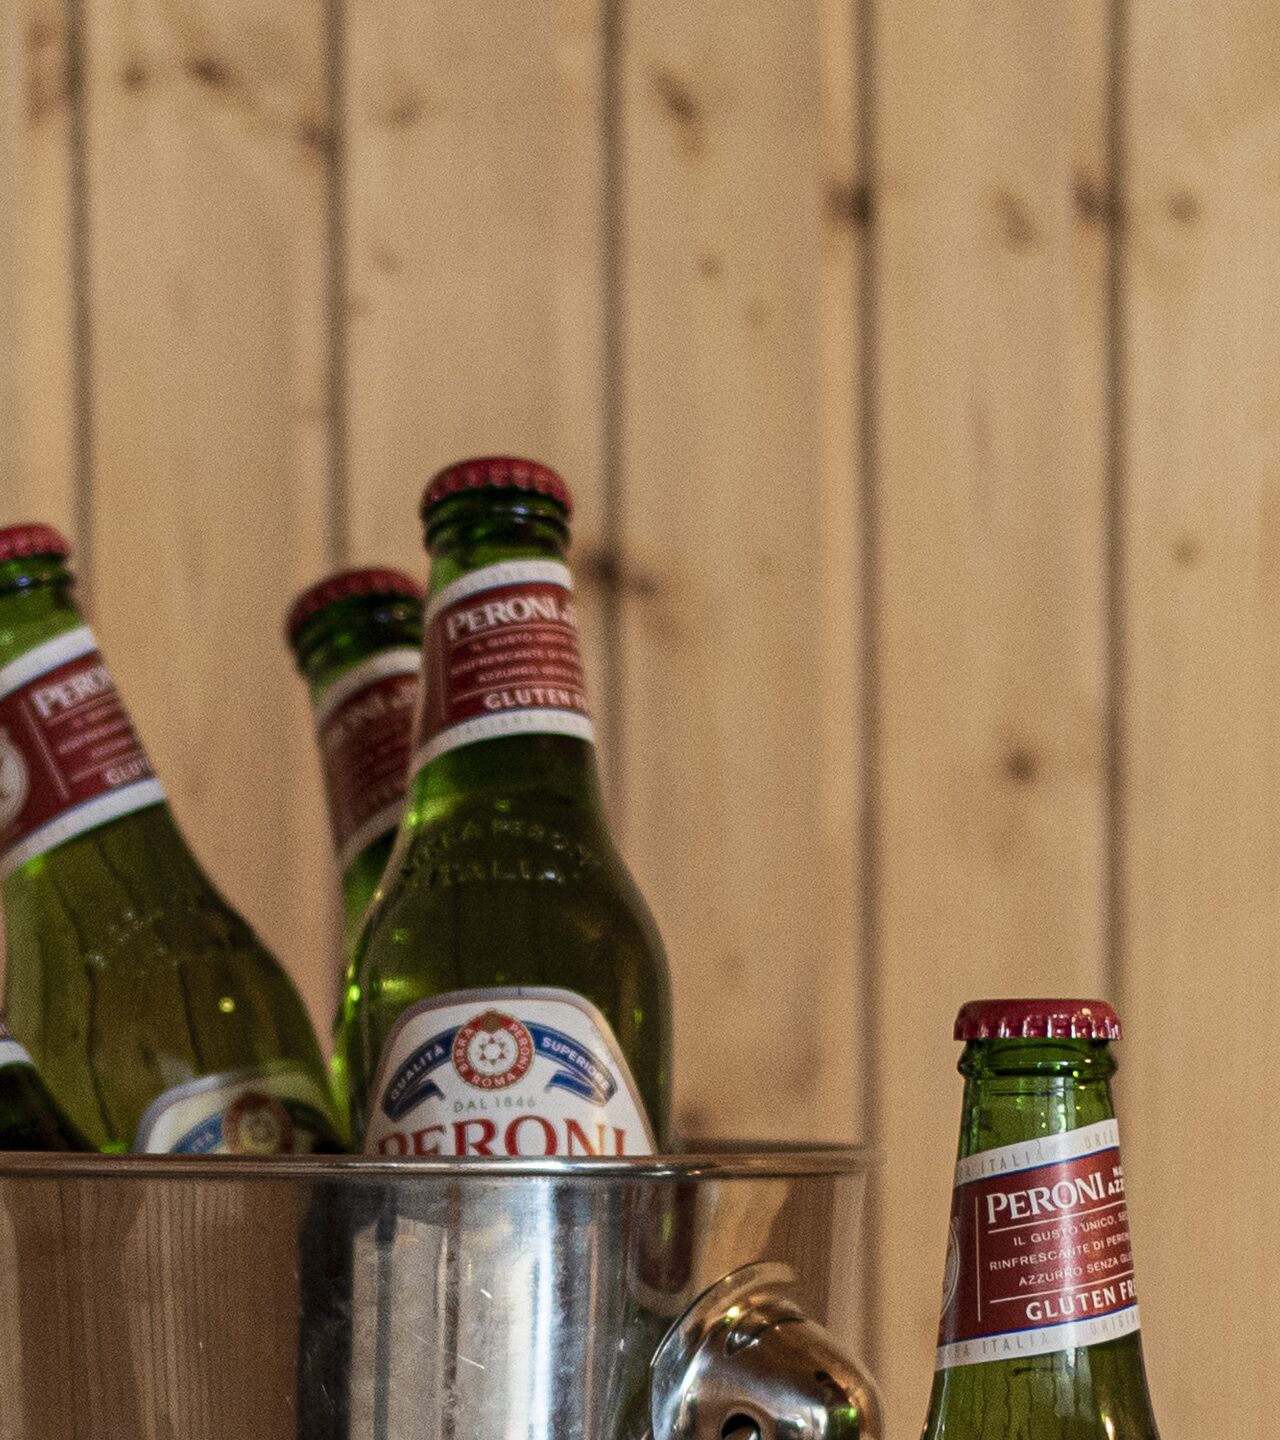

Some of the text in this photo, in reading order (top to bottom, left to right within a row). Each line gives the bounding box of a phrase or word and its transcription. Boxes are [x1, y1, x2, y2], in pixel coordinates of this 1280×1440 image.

[446, 597, 559, 641] PERONI
[485, 688, 570, 709] GLUTEN
[391, 1036, 609, 1100] QUALITÀ SUPERIORE
[471, 1072, 515, 1088] ROMA
[454, 1098, 488, 1113] DAL
[377, 1114, 626, 1157] PERONI
[986, 1171, 1106, 1225] PERONI
[1013, 1237, 1025, 1246] IL
[1031, 1226, 1078, 1244] GUSTO
[989, 1243, 1090, 1272] RINFRESCANTE
[1093, 1239, 1105, 1251] DI
[1019, 1266, 1083, 1287] AZZURRO
[1087, 1257, 1119, 1273] SENZA
[1026, 1286, 1117, 1321] GLUTEN
